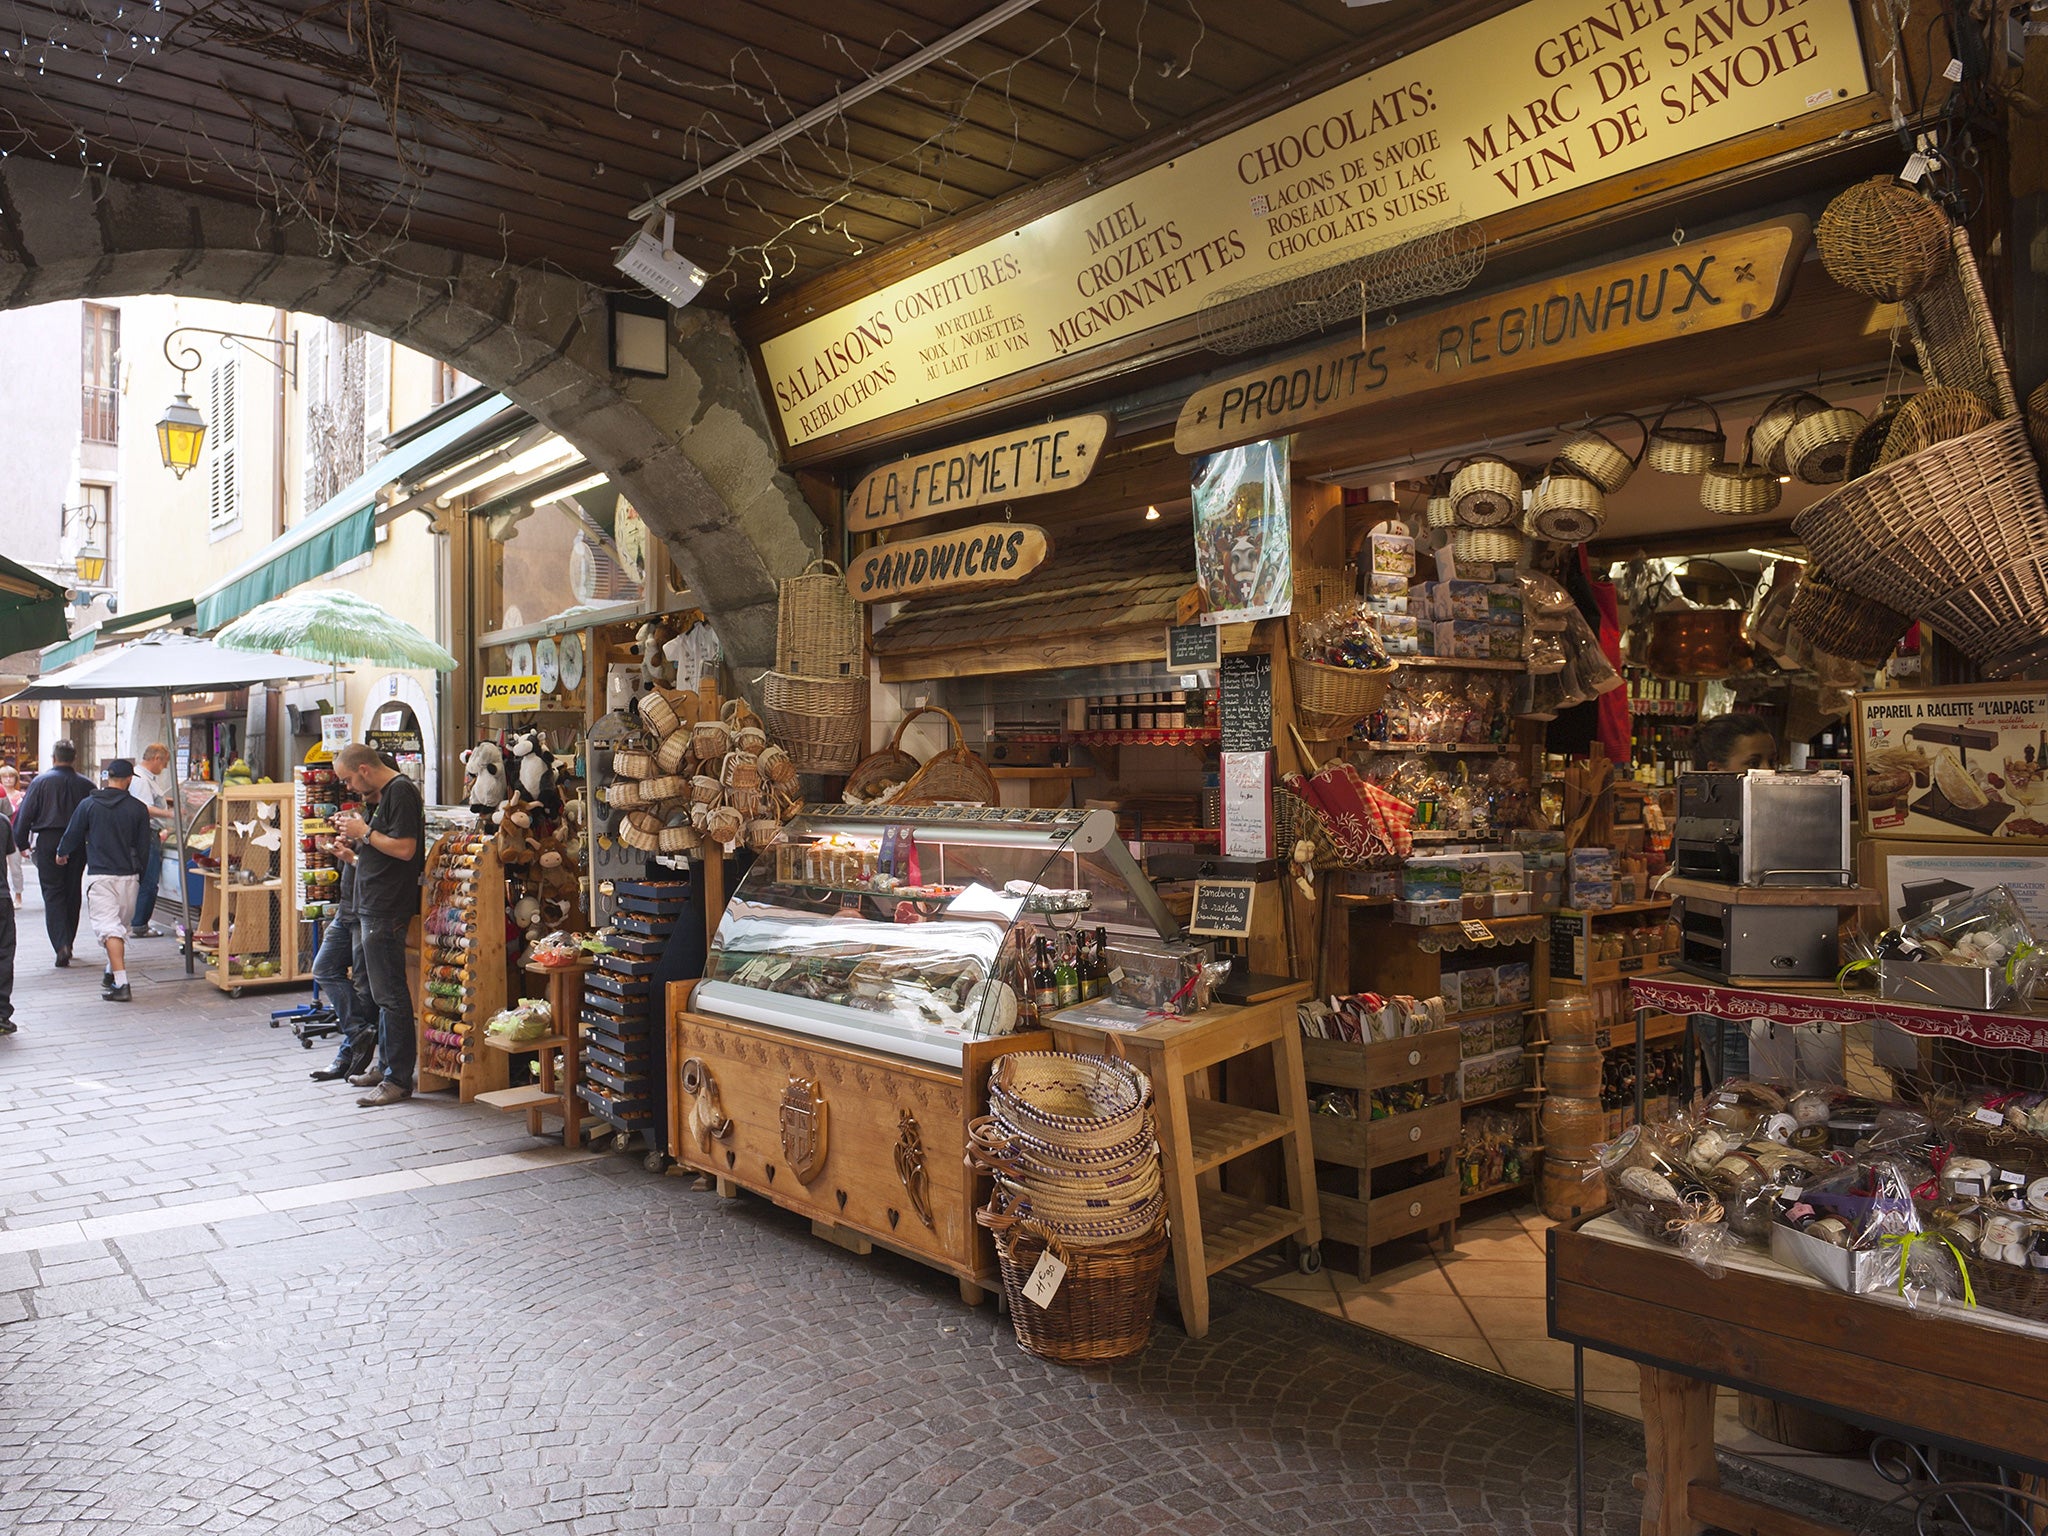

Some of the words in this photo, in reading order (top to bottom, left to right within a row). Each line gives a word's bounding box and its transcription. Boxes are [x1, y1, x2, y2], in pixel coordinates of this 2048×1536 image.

[1534, 0, 1694, 79] GENE
[1462, 83, 1581, 171] MARC
[1588, 46, 1651, 105] DE
[1663, 0, 1808, 68] SAVO
[1493, 136, 1577, 200] VIN
[1586, 103, 1648, 160] DE
[1660, 19, 1818, 125] SAVOIE
[1237, 81, 1437, 185] CHOCOLATS:
[1256, 168, 1336, 215] LACONS
[1339, 157, 1368, 185] DE
[1372, 129, 1441, 172] SAVOIE
[1083, 201, 1147, 256] MIEL
[1266, 190, 1353, 238] ROSEAUX
[1358, 175, 1389, 204] DU
[1394, 158, 1437, 191] LAC
[1267, 206, 1378, 262] CHOCOLATS
[1383, 181, 1451, 222] SUISSE
[893, 252, 1022, 324] CONFITURES:
[1047, 229, 1247, 353] MIGNONNETTES
[1076, 220, 1183, 298] CROZETS
[775, 310, 894, 413] SALAISONS
[918, 342, 950, 366] NOIX
[960, 313, 1026, 351] NOISETTES
[926, 364, 941, 382] AU
[944, 353, 970, 376] LAIT
[984, 343, 1001, 362] AU
[1004, 332, 1031, 354] VIN
[934, 304, 995, 340] MYRTILLE
[1217, 345, 1390, 430] PRODUITS
[1432, 255, 1722, 374] REGIONAUX
[798, 360, 898, 438] REBLOCHONS
[865, 471, 900, 520] LA
[909, 430, 1070, 510] FERMETTE
[860, 530, 1025, 594] SANDWICHS
[486, 684, 509, 698] SACS
[509, 684, 517, 695] A
[518, 681, 538, 695] DOS
[1866, 703, 1913, 720] APPAREIL
[1916, 703, 1924, 717] A
[1927, 702, 1974, 718] RACLETTE
